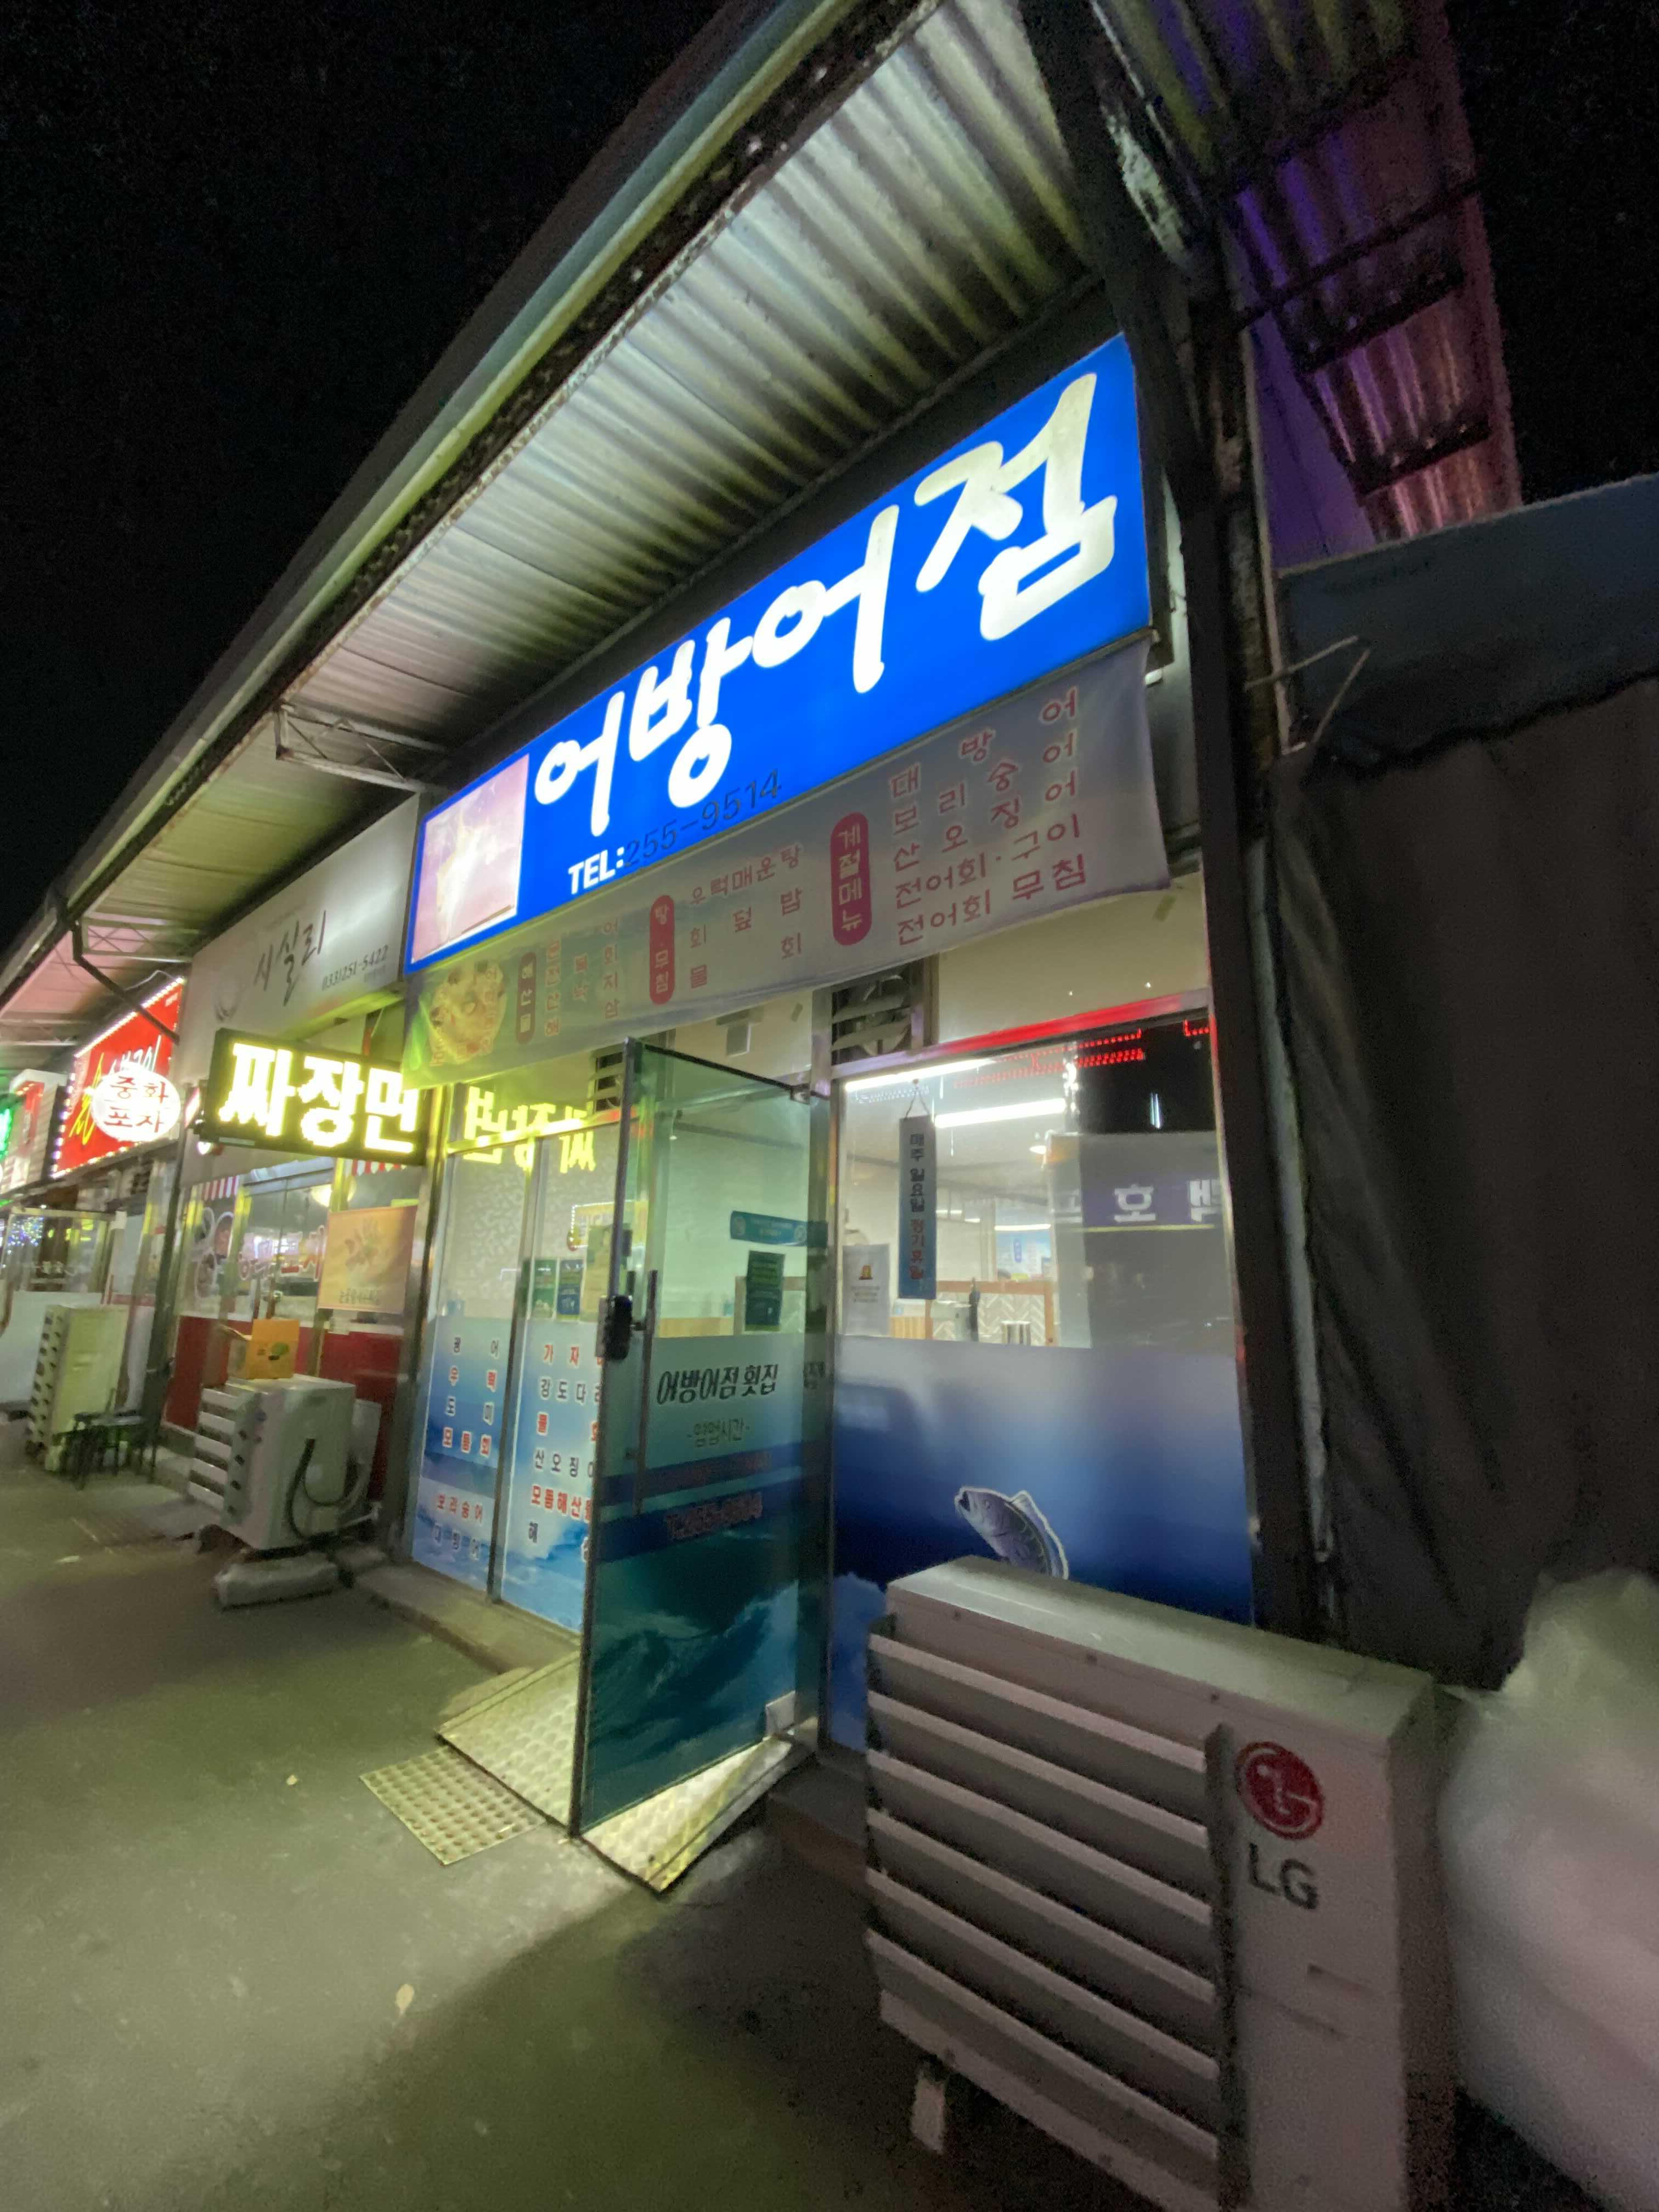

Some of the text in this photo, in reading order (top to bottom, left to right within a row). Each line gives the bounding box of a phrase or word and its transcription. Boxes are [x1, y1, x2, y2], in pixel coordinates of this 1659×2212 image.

[534, 373, 1116, 837] 어방어점
[890, 689, 1078, 799] 대방어
[893, 770, 1077, 872] 산오징어
[689, 843, 804, 905] 우럭매운탕
[689, 887, 804, 949] 회덮밥
[837, 822, 864, 932] 계절메뉴
[897, 854, 1088, 946] 전어회 무침
[690, 932, 803, 990] 물회
[109, 1074, 170, 1105] 중화
[218, 1042, 420, 1153] 짜장면
[1249, 1842, 1319, 1909] LG
